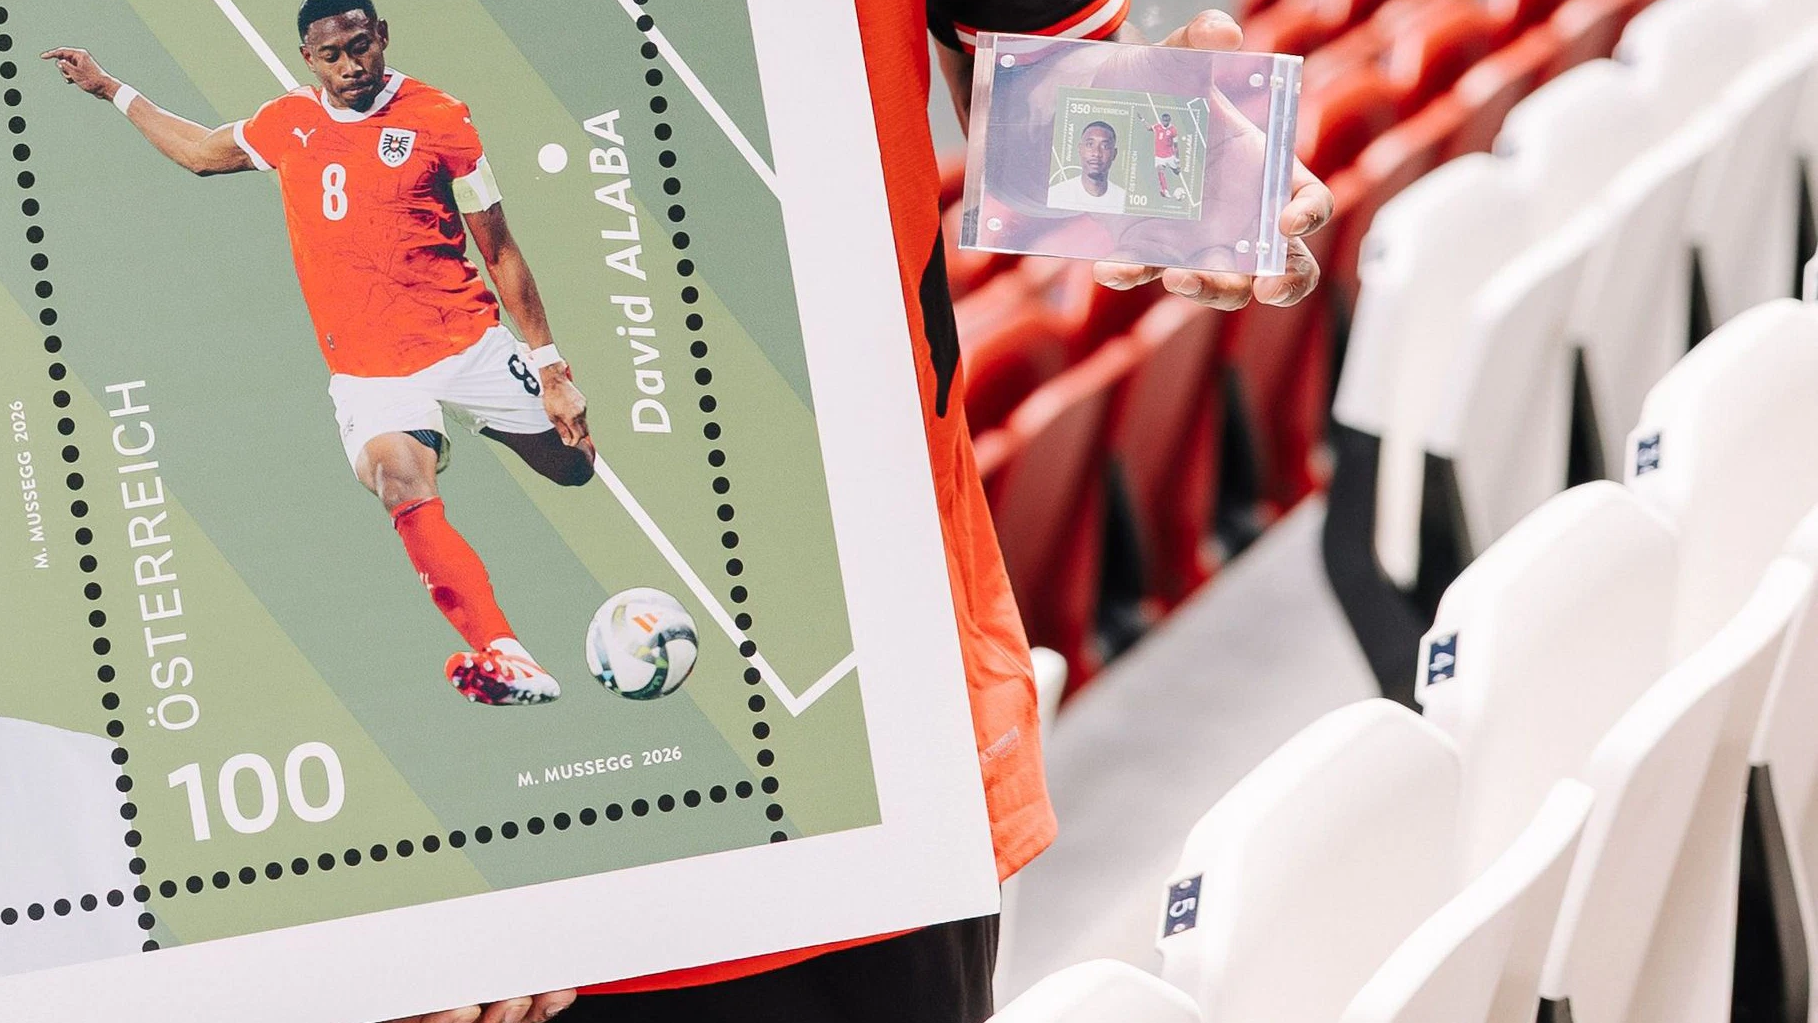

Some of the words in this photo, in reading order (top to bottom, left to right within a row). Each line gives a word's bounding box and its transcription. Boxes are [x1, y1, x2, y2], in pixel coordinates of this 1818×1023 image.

[1070, 103, 1091, 114] 350
[322, 163, 348, 221] 8
[583, 109, 647, 281] ALABA
[1129, 195, 1148, 206] 100
[609, 295, 672, 433] David
[8, 399, 28, 443] 2026
[16, 451, 46, 543] MUSSEGG
[33, 546, 51, 569] M.
[104, 380, 200, 731] ÖSTERREICH
[167, 741, 345, 842] 100
[517, 770, 539, 788] M.
[544, 754, 633, 783] MUSSEGG
[641, 745, 682, 766] 2026
[1169, 897, 1197, 918] 5
